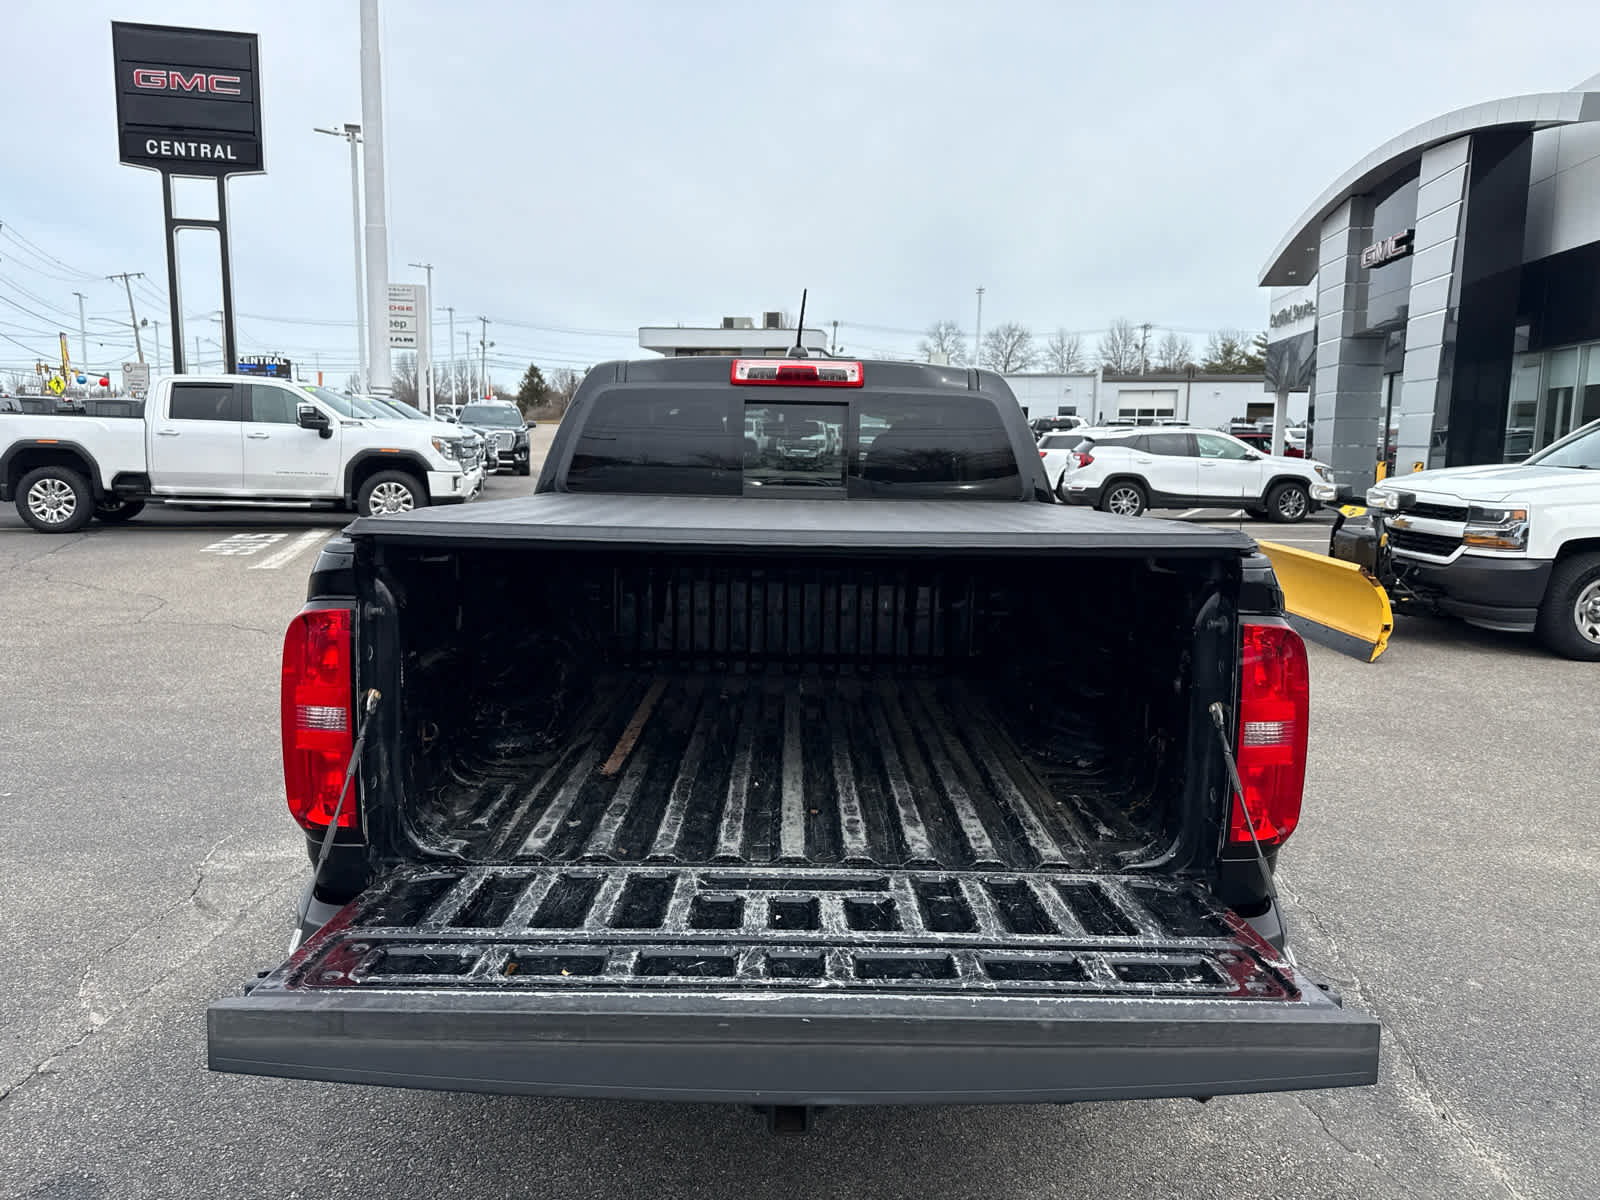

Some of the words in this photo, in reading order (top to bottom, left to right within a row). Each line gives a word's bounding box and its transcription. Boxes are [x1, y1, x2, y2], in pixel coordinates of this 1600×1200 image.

[134, 69, 240, 94] GMC
[146, 140, 237, 159] CENTRAL
[1361, 232, 1408, 268] GMC
[389, 319, 407, 329] ep
